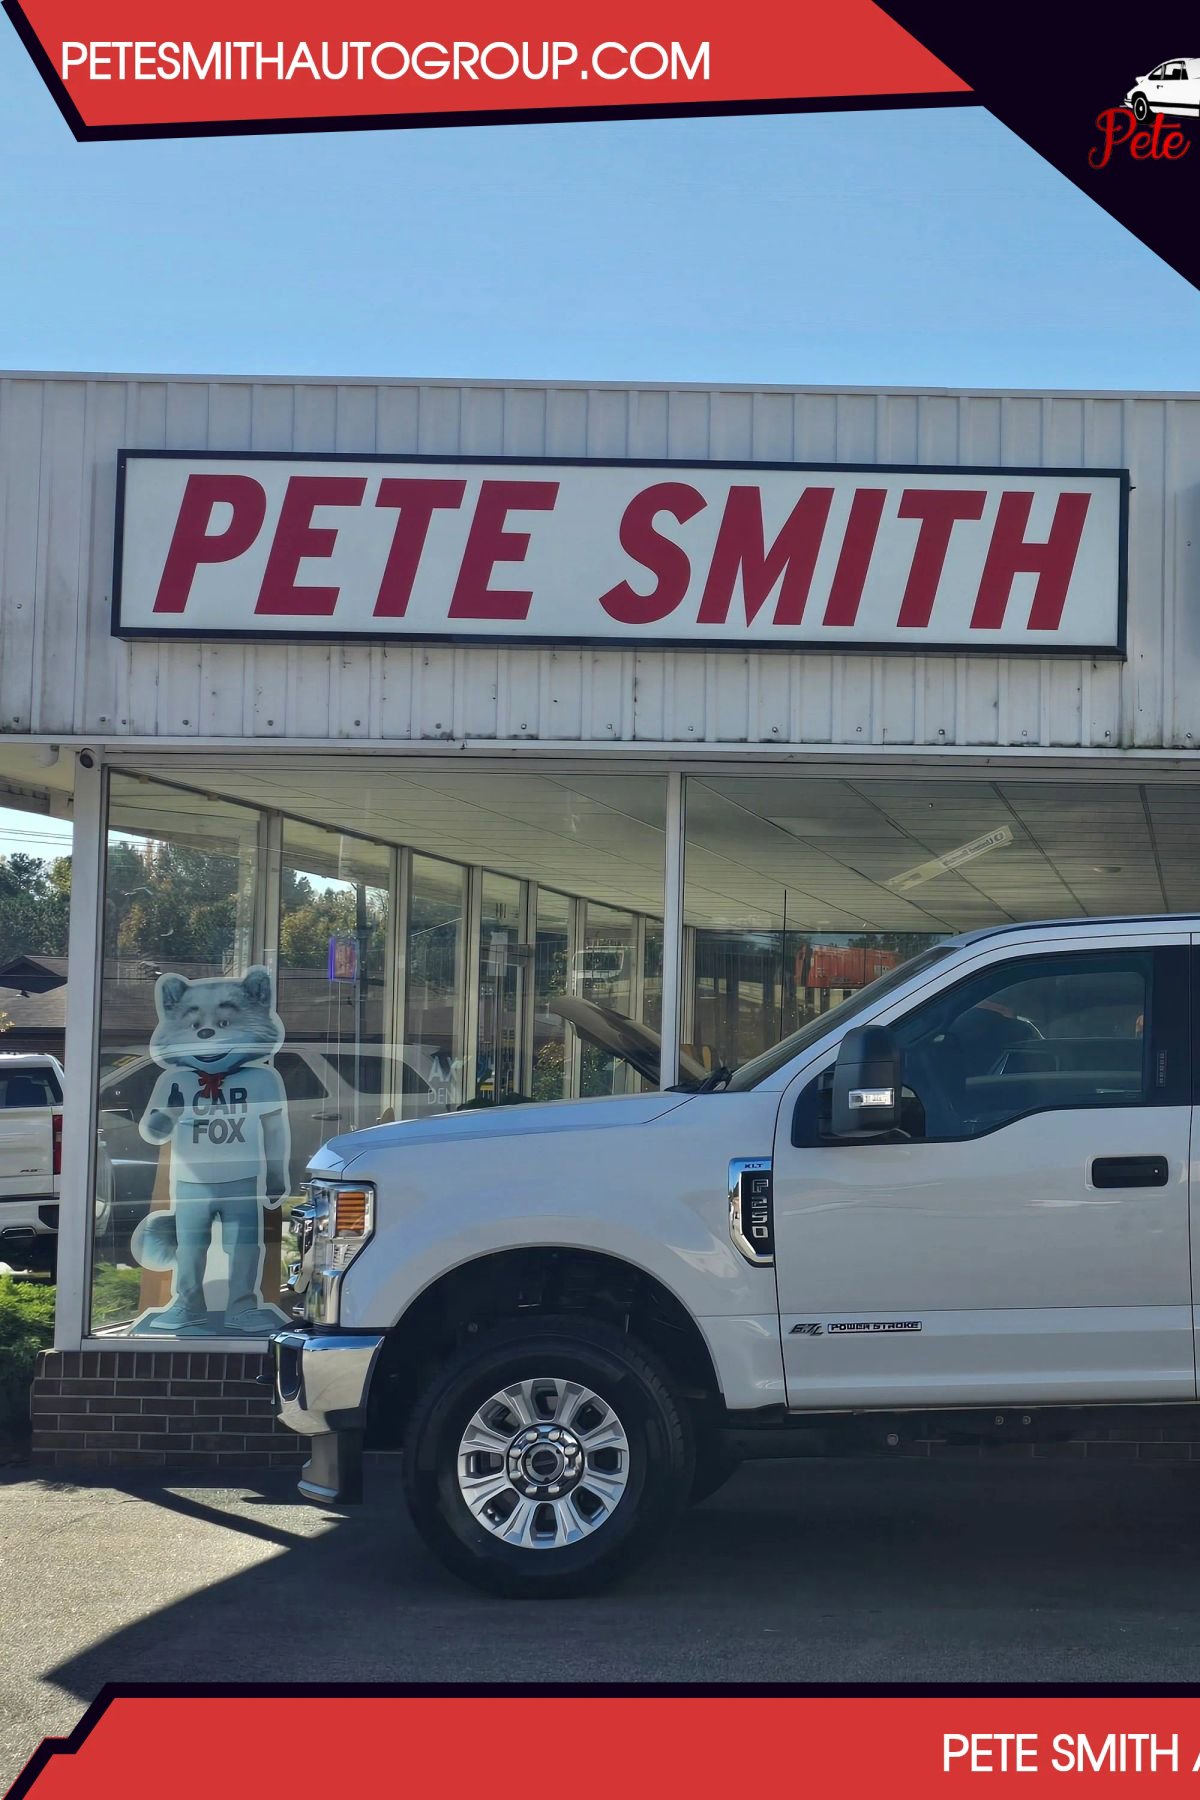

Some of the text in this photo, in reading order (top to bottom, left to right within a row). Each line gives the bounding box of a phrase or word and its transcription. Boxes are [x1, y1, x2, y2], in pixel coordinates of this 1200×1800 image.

[155, 475, 1089, 630] PETE SMITH
[192, 1087, 248, 1116] CAR
[192, 1117, 246, 1144] FOX
[831, 1322, 871, 1331] POWER
[872, 1320, 919, 1330] STROKE
